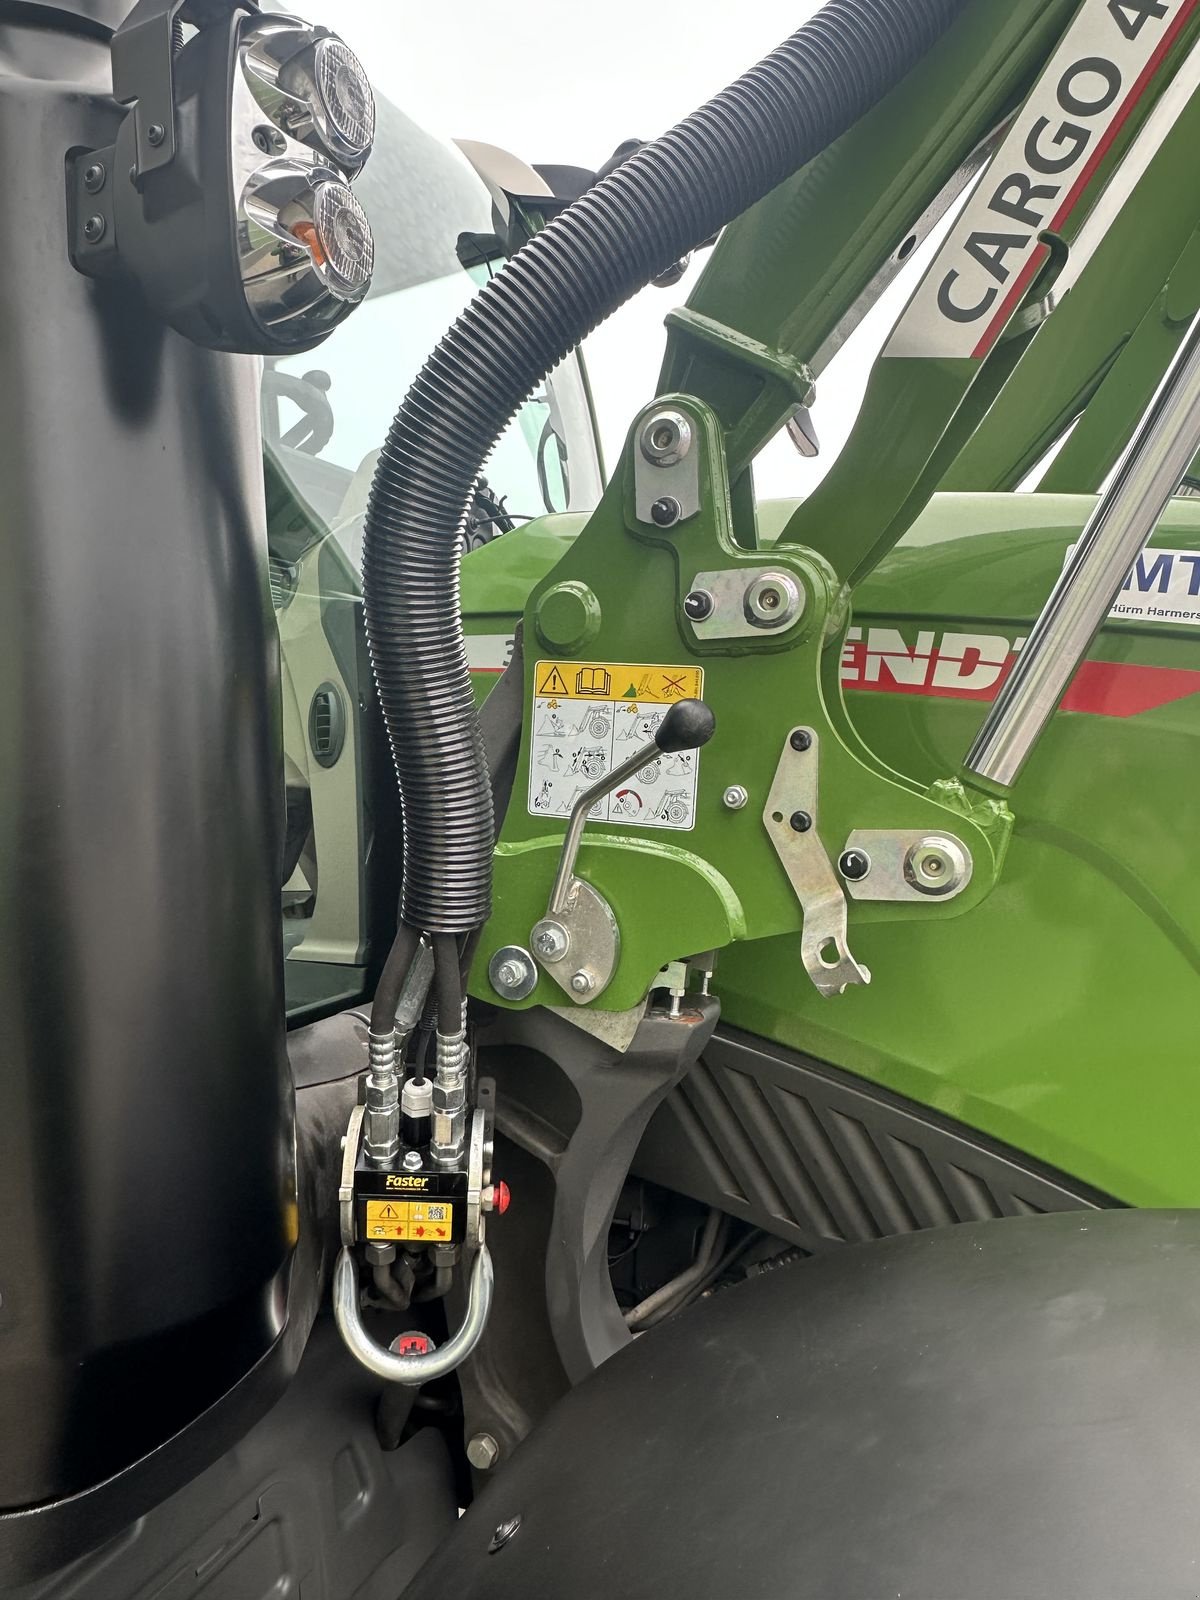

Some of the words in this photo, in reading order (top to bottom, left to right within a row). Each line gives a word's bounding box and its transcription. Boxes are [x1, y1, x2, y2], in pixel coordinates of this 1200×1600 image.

[937, 57, 1122, 323] CARGO
[1107, 0, 1169, 41] 4
[840, 627, 1027, 690] END
[385, 1174, 429, 1187] Faster
